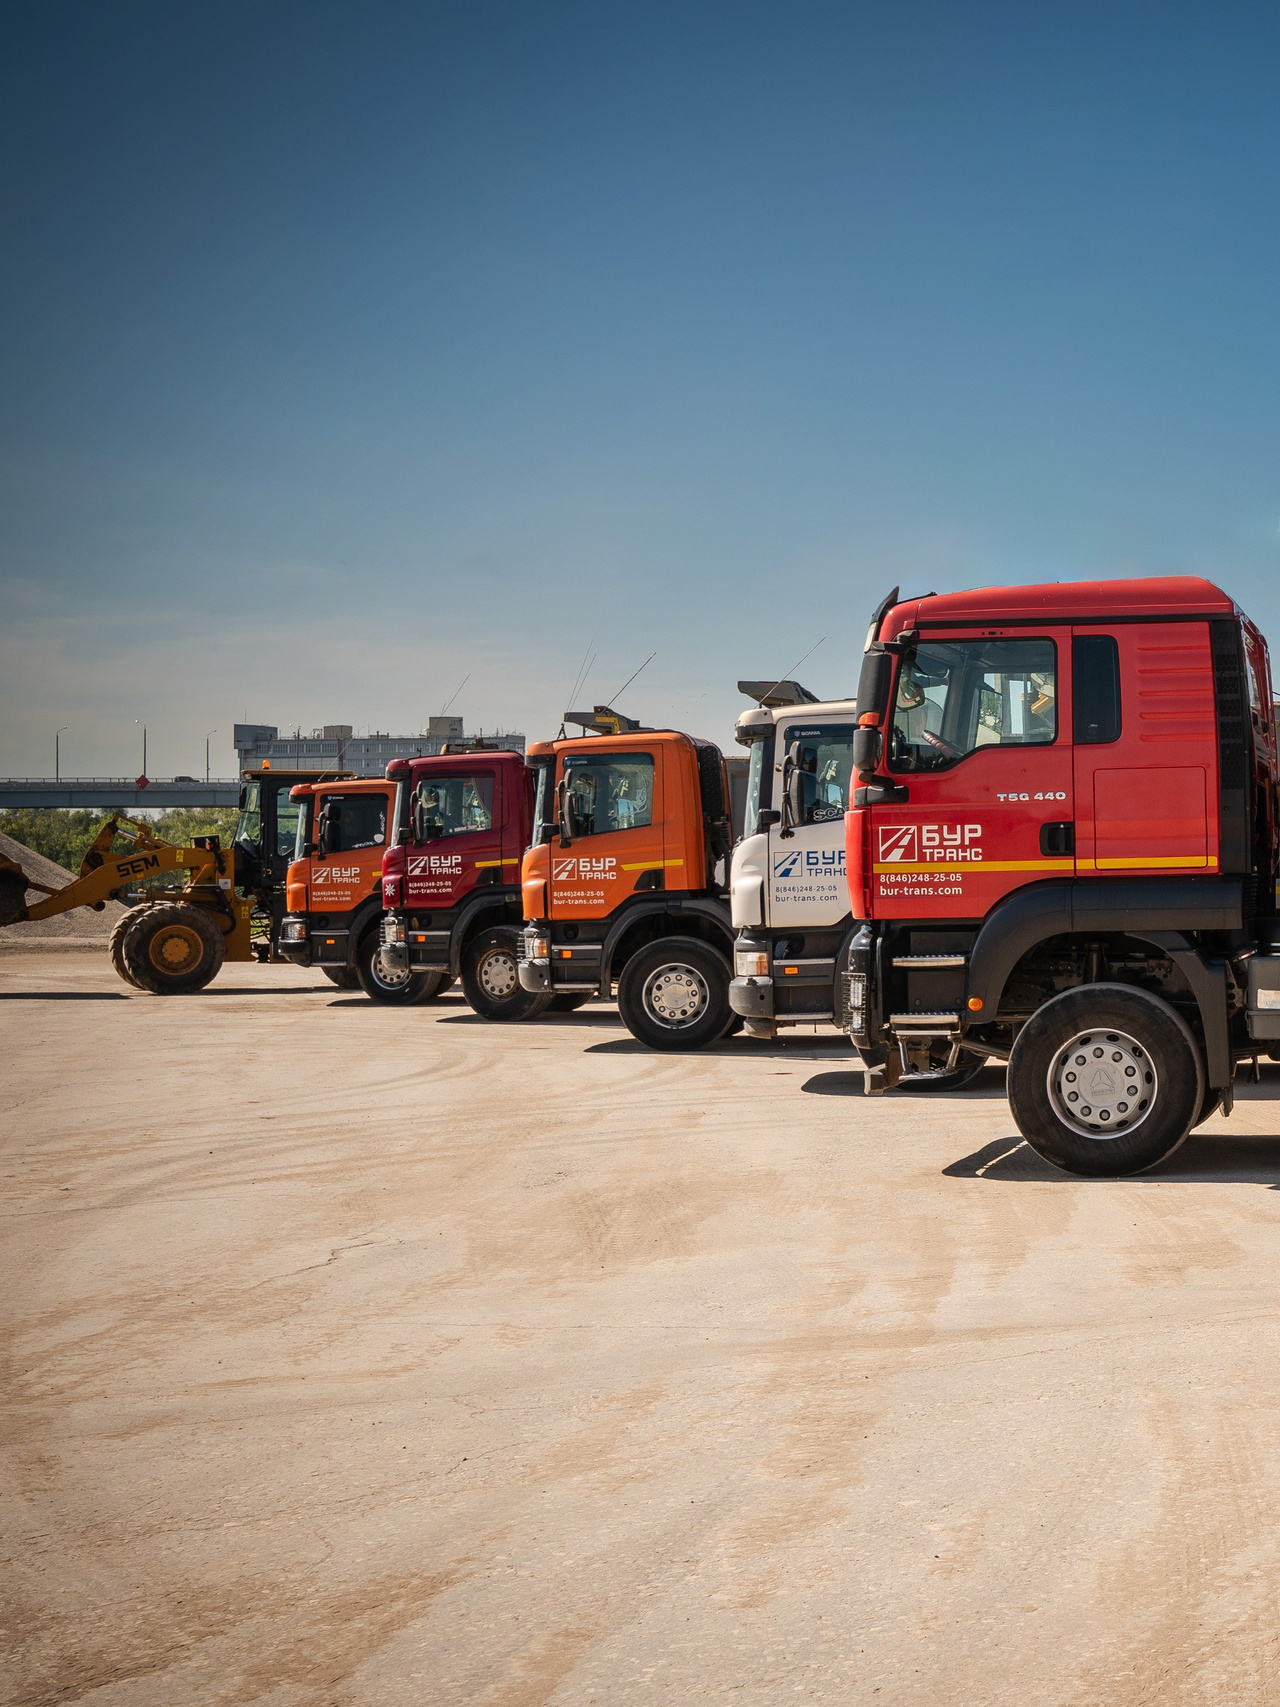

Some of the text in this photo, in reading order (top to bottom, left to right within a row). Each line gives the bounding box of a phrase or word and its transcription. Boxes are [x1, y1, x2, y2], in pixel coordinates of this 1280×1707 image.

[996, 791, 1066, 802] T5G 440
[813, 805, 848, 821] SCA
[922, 824, 982, 846] БУР
[922, 848, 983, 862] ТРАНС
[116, 854, 160, 878] SEM
[430, 856, 462, 867] БУР
[580, 857, 617, 871] БУР
[332, 867, 360, 877] БУР
[430, 867, 462, 875] ТРАНС
[580, 872, 617, 880] ТРАНС
[879, 873, 962, 884] 8(846)248-25-05
[775, 885, 838, 894] 8(846)248-25-05
[879, 885, 963, 896] bur-trans.com
